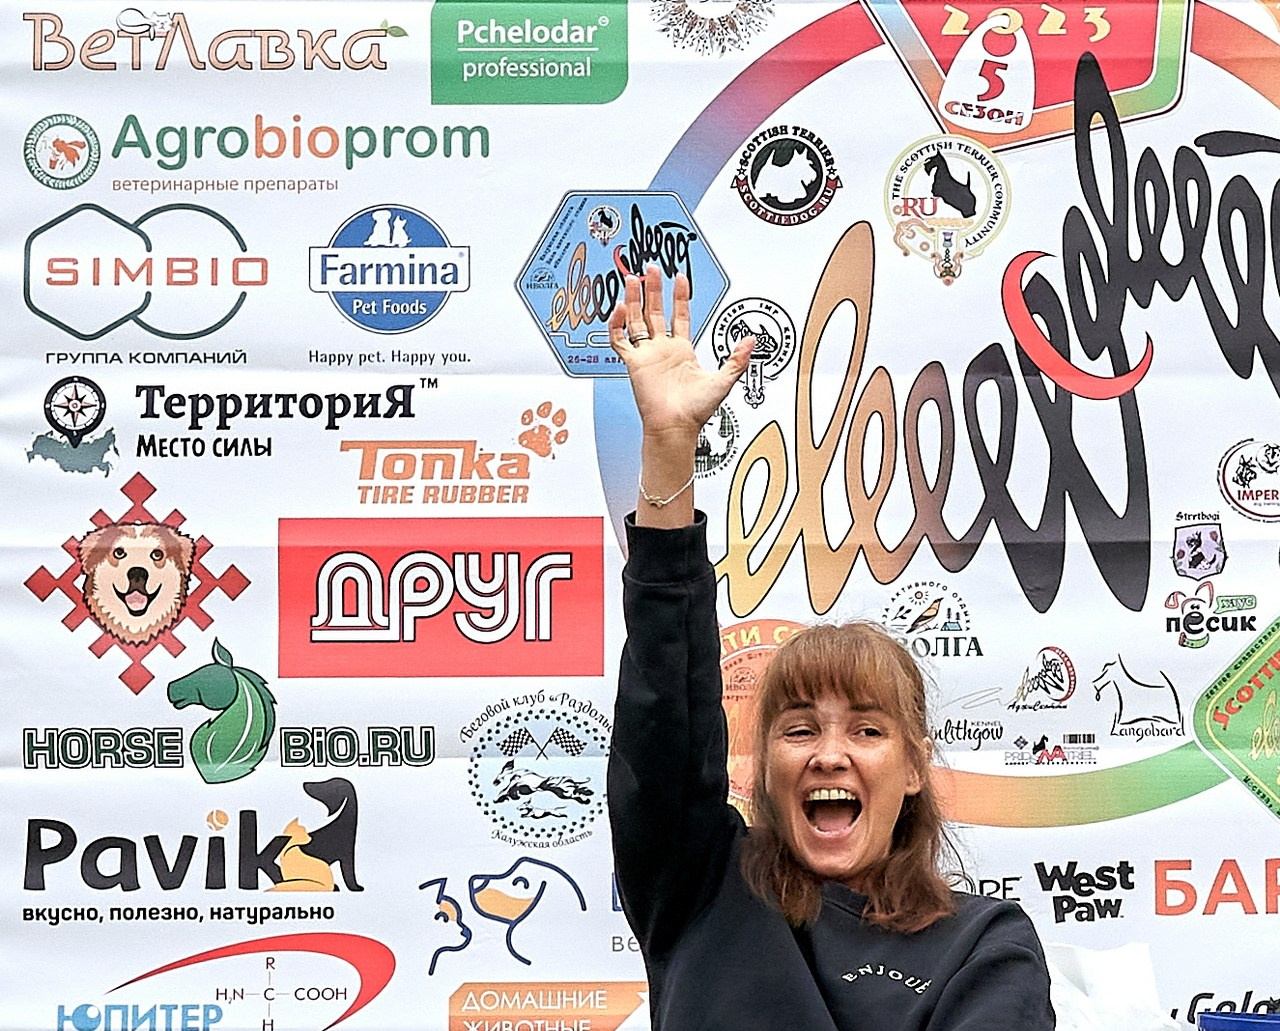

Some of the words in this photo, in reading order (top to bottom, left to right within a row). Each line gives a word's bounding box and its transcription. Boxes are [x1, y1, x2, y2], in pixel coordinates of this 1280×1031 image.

[457, 19, 598, 46] Pchelodar
[463, 57, 592, 79] professional
[976, 60, 1008, 102] 5
[112, 114, 490, 170] Agrobioprom
[739, 126, 788, 168] SCOTTISH
[792, 126, 834, 166] TERRIER
[900, 141, 952, 174] SCOTTISH
[956, 142, 999, 184] TERRIER
[112, 178, 239, 192] ветеринарные
[244, 178, 338, 192] препараты
[46, 257, 269, 287] SIMBIO
[320, 252, 459, 288] Farmina
[352, 299, 378, 315] Pet
[382, 299, 427, 315] Foods
[46, 353, 122, 364] ГРУППА
[129, 350, 247, 364] КОМПАНИЙ
[309, 350, 347, 366] Happy
[353, 350, 385, 366] pet.
[392, 350, 436, 366] Happy
[441, 352, 471, 366] you.
[340, 440, 530, 480] Tonka
[359, 485, 414, 504] TIRE
[423, 485, 529, 504] RUBBER
[310, 551, 573, 644] ДРУГ
[513, 689, 545, 707] клуб
[23, 728, 183, 768] HORSE
[26, 809, 291, 892] Pavik
[1034, 860, 1135, 897] West
[23, 907, 103, 923] вкусно,
[110, 907, 204, 923] полезно,
[210, 905, 334, 923] натурально
[1053, 895, 1121, 923] Paw
[265, 957, 276, 971] R
[295, 986, 347, 1001] COOH
[461, 990, 608, 1012] ДОМАШНИЕ
